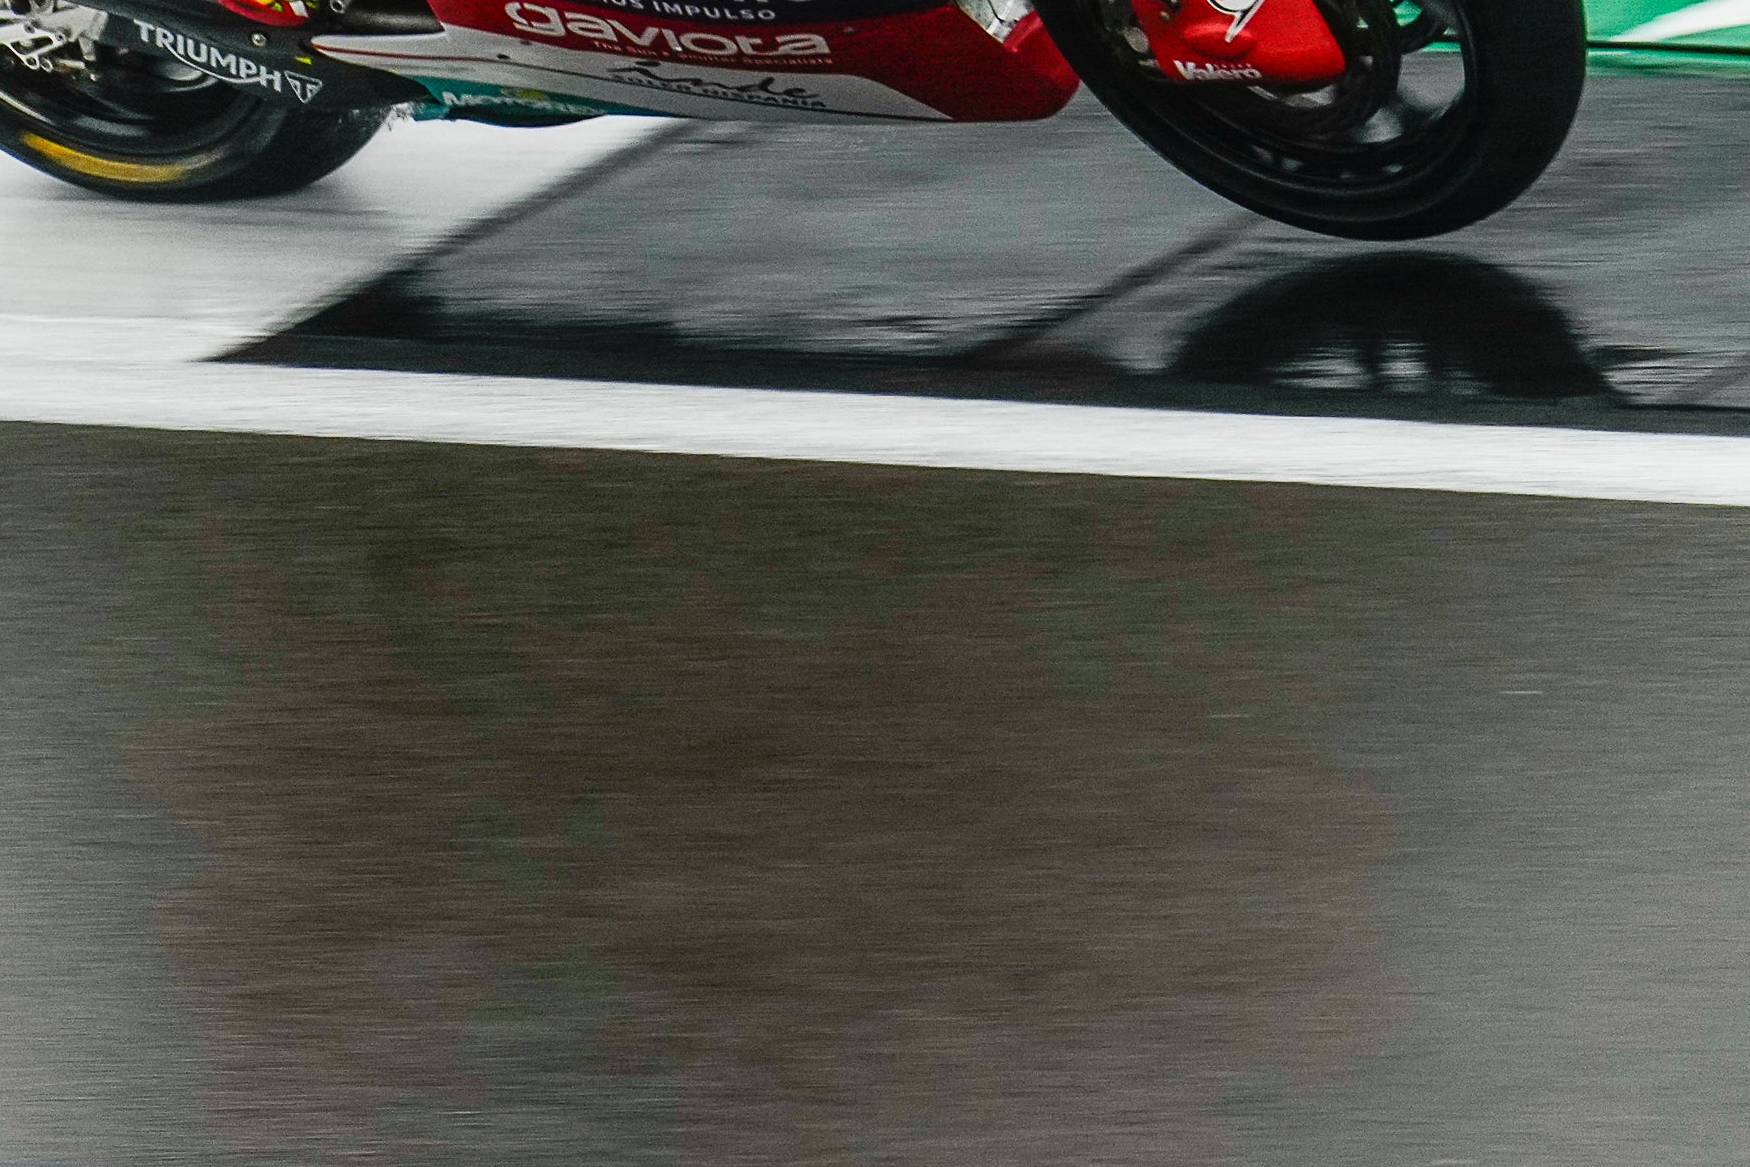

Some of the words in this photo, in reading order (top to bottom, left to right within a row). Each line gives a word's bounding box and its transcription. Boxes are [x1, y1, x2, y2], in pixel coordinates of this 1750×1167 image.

[505, 1, 833, 59] gaviota
[653, 0, 776, 22] IMPULSO
[133, 18, 282, 92] TRIUMPH
